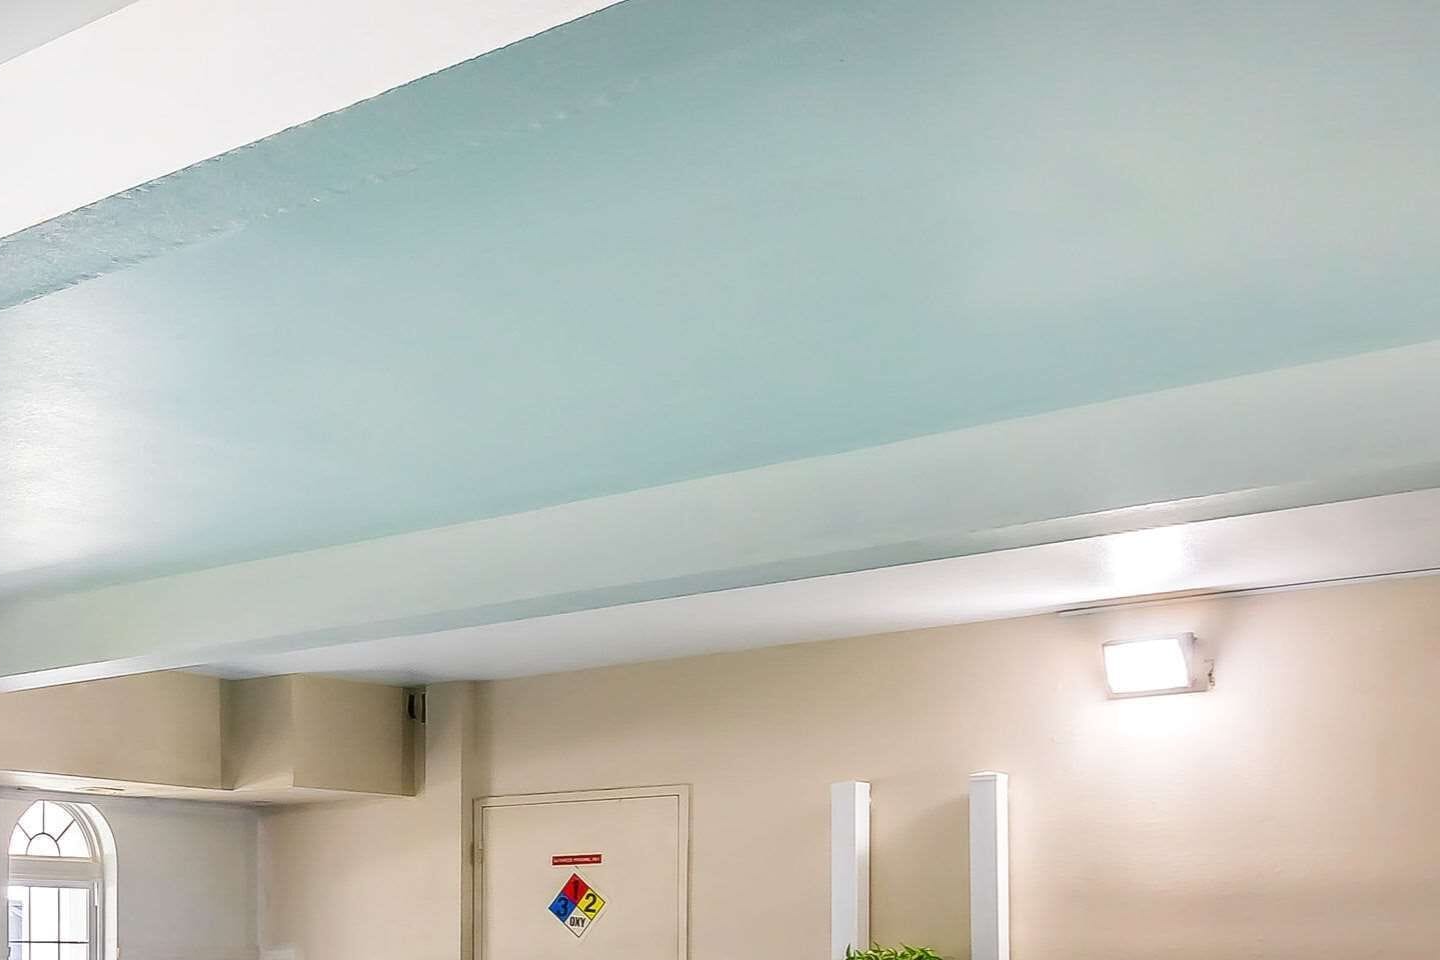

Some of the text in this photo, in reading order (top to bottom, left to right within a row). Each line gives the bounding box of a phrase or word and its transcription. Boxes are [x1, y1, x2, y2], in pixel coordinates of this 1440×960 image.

[556, 896, 569, 917] 3
[584, 893, 597, 913] 2
[569, 916, 586, 928] OXY
